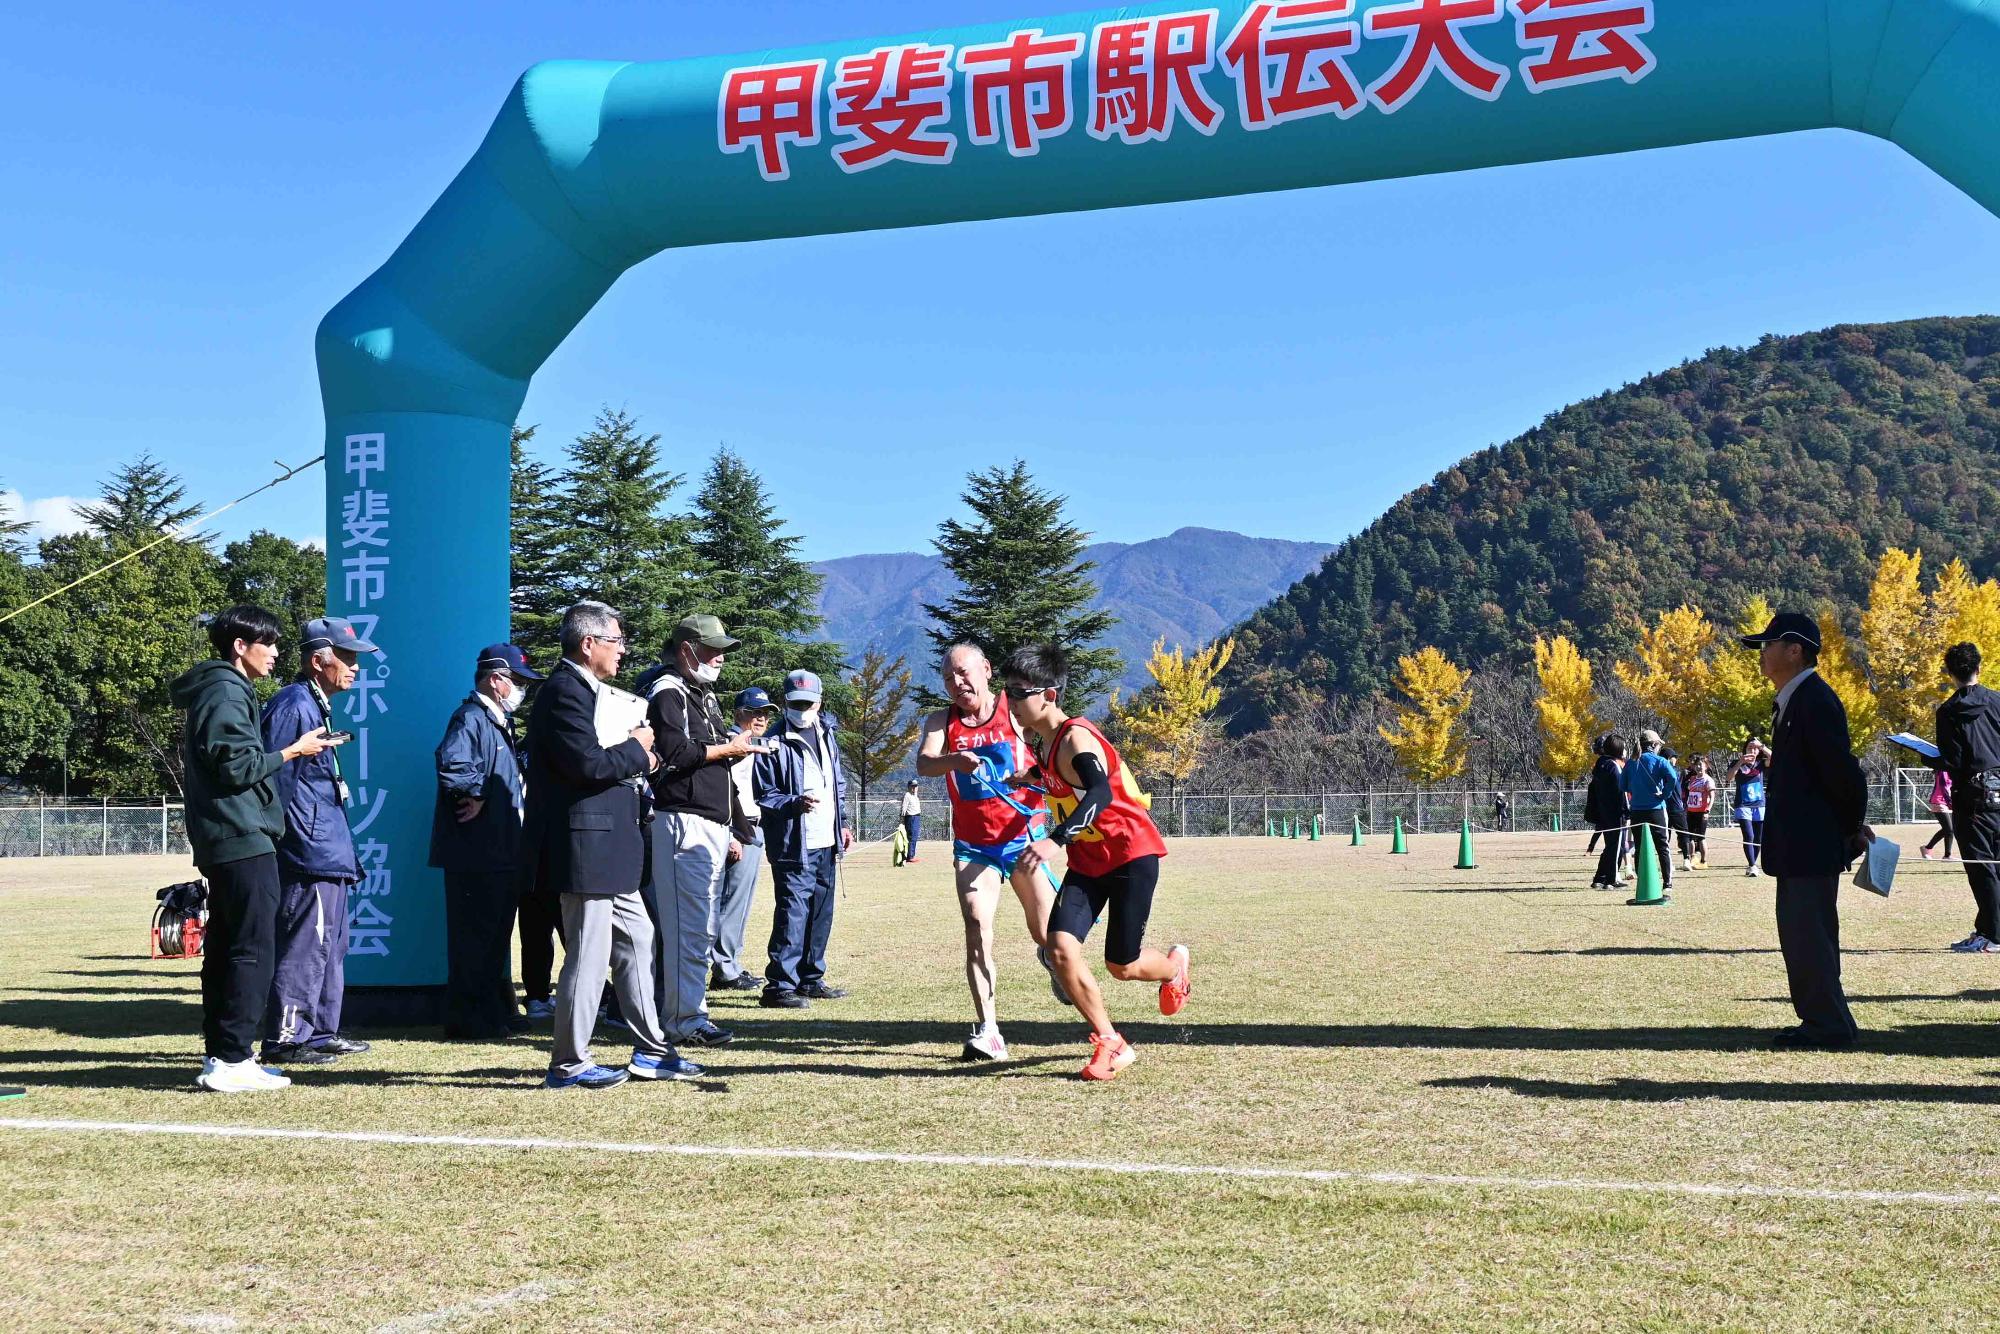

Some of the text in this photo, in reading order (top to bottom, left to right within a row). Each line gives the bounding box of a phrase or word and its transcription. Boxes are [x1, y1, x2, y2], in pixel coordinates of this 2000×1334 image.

[717, 0, 1656, 182] 甲斐市駅伝大会
[342, 431, 393, 957] 甲斐市スポーツ協会
[954, 730, 1005, 750] さかい
